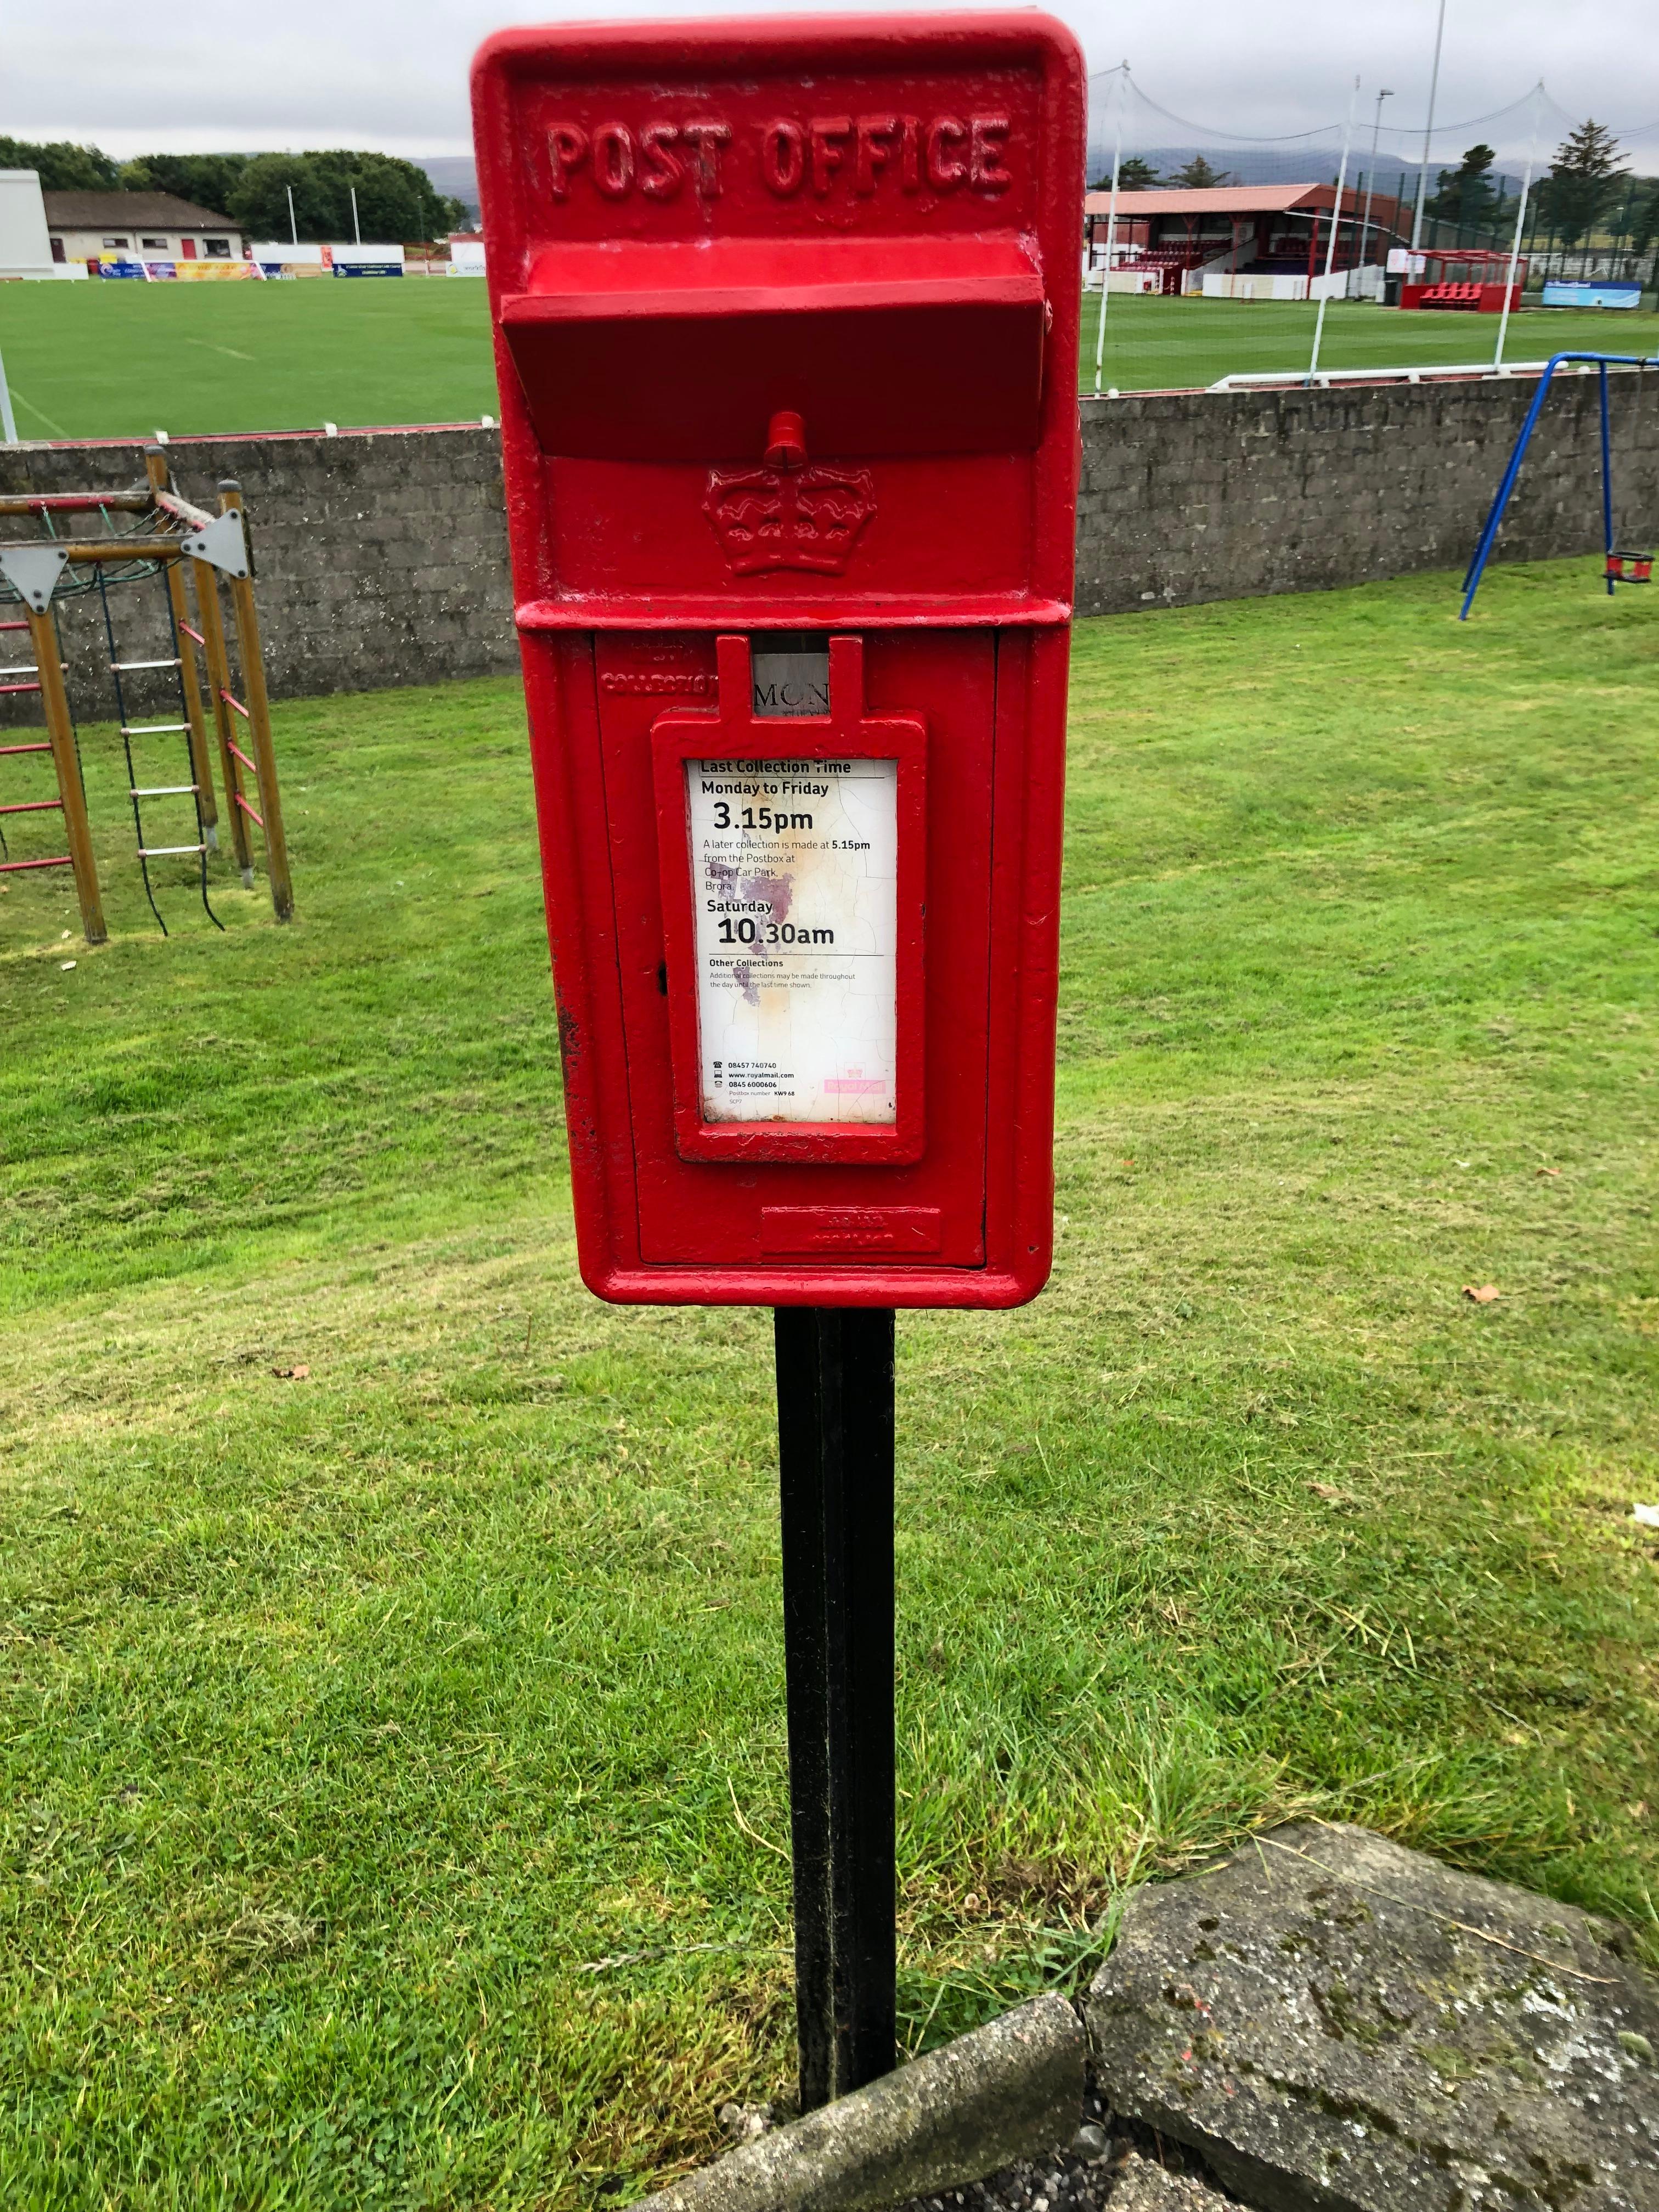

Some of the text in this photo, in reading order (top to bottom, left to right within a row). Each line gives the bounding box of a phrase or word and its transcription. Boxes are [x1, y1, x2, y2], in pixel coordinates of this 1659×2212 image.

[549, 115, 1013, 200] POST OFFICE
[754, 683, 830, 707] MON
[701, 760, 851, 773] Last Collection Time
[702, 781, 829, 797] Monday to Friday
[713, 802, 813, 834] 3.15pm
[703, 840, 710, 848] A
[712, 840, 733, 849] later
[736, 840, 780, 849] collection
[792, 840, 818, 849] made
[820, 841, 830, 849] at
[832, 840, 870, 851] 5.15pm
[704, 854, 795, 863] from the Postbox at
[705, 867, 733, 878] Co-op
[736, 867, 752, 876] Car
[707, 900, 773, 915] Saturday
[718, 918, 834, 944] 10.30am
[722, 981, 733, 990] day
[827, 1081, 856, 1091] Royal
